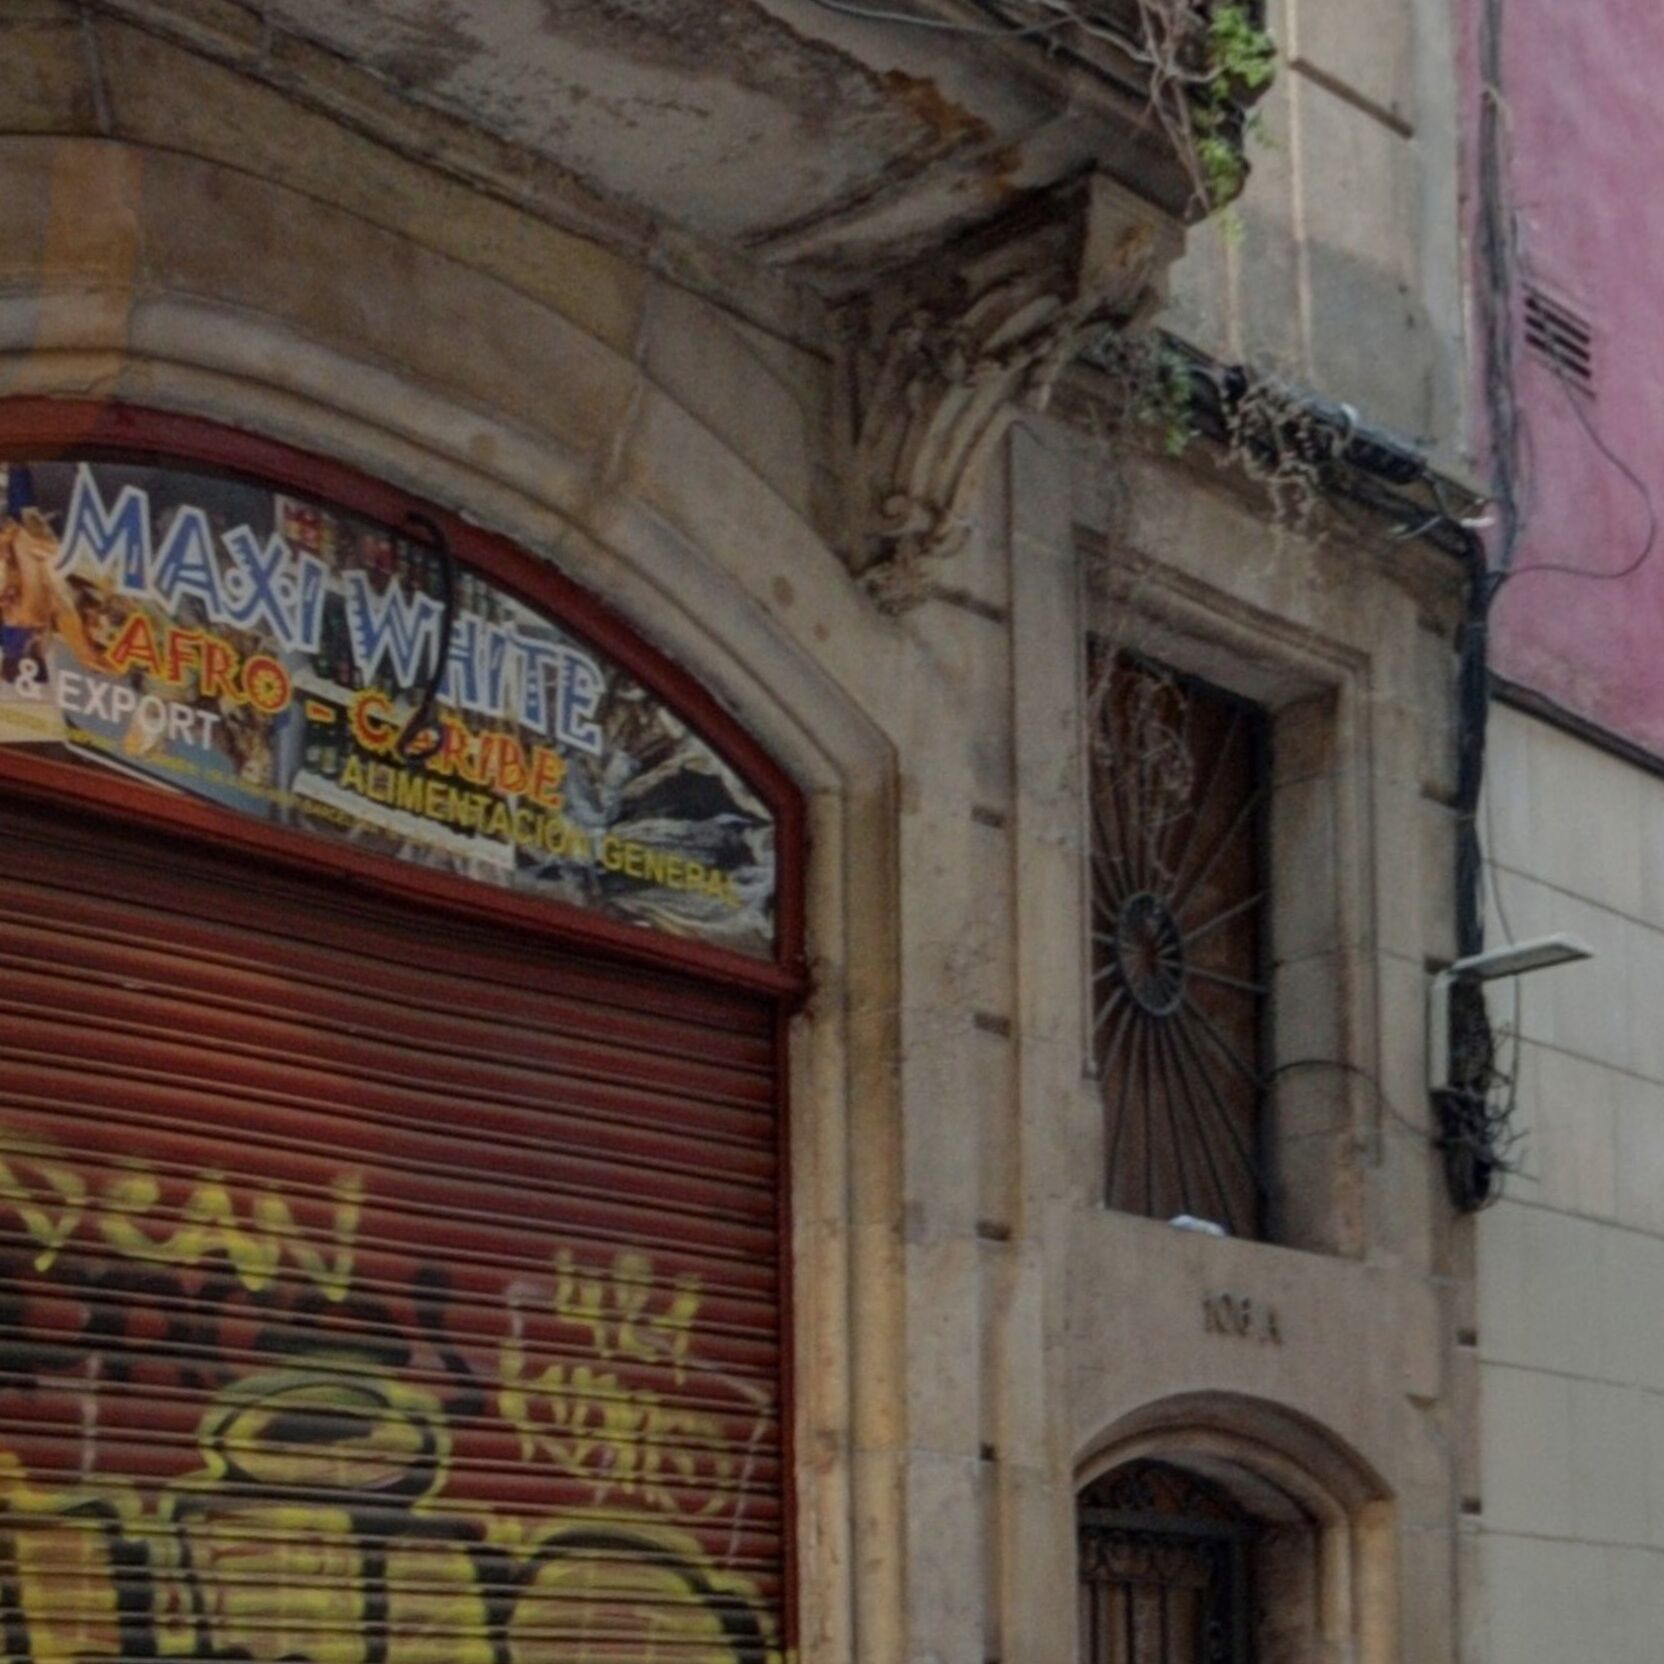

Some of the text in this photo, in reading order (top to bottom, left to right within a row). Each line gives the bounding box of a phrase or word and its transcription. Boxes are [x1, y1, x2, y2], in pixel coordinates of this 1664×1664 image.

[56, 462, 606, 756] MAXI WHITE
[14, 657, 49, 704] &
[56, 668, 224, 752] EXPORT
[104, 607, 295, 713] AFRO
[601, 834, 744, 912] GENERAL
